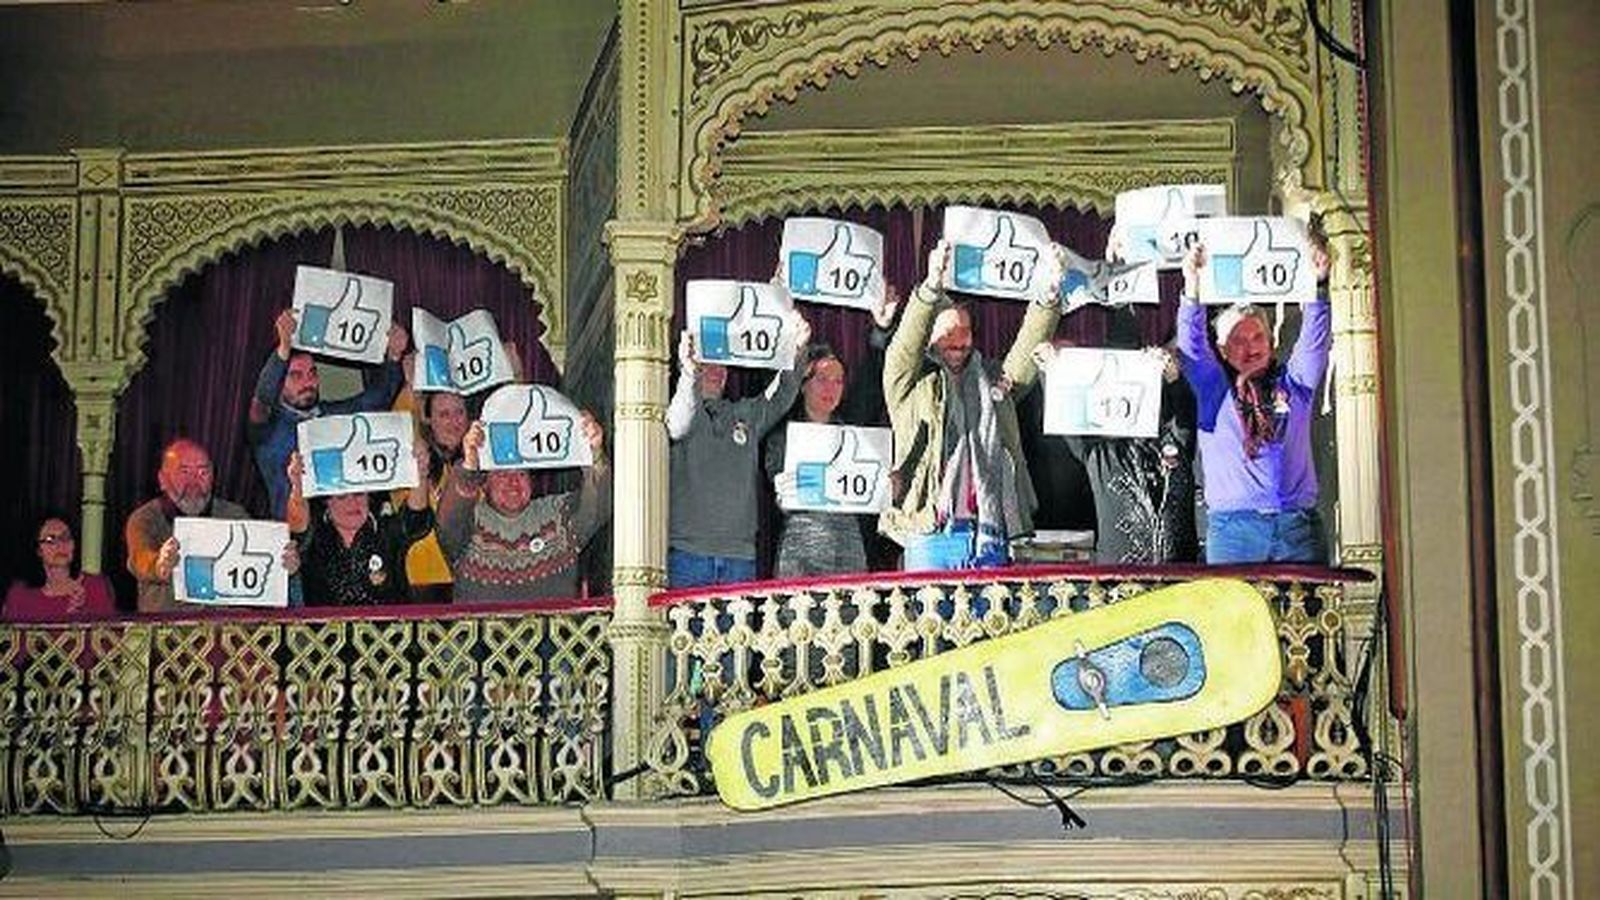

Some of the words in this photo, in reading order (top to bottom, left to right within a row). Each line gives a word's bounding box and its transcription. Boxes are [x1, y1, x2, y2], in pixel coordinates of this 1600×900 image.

[830, 267, 859, 291] 10
[995, 259, 1024, 284] 10
[1256, 264, 1287, 287] 10
[337, 321, 364, 345] 10
[741, 330, 769, 351] 10
[457, 356, 484, 381] 10
[530, 430, 560, 454] 10
[356, 452, 388, 475] 10
[837, 474, 867, 496] 10
[227, 567, 258, 591] 10
[740, 665, 1031, 799] CARNAVAL
